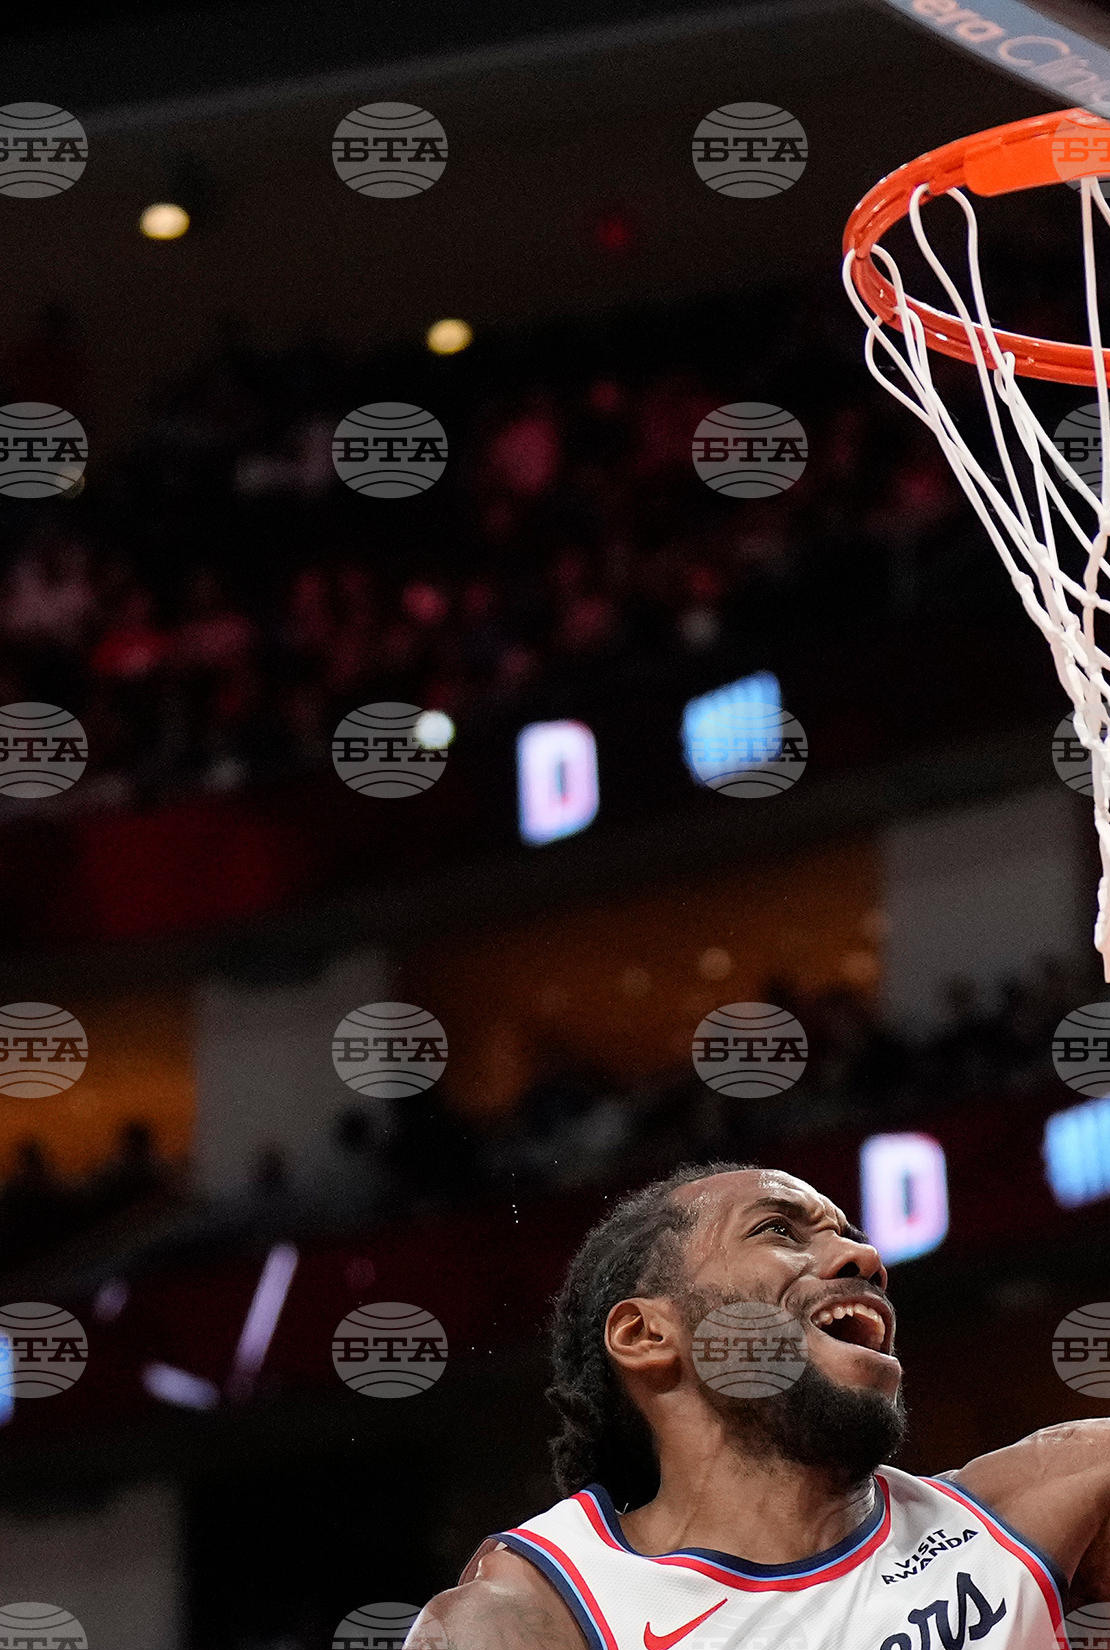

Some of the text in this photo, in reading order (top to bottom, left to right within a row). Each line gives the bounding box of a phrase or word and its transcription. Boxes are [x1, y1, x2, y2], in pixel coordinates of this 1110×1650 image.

[517, 718, 600, 847] D
[860, 1132, 949, 1267] D
[881, 1528, 979, 1585] RWANDA
[894, 1528, 947, 1569] VISIT
